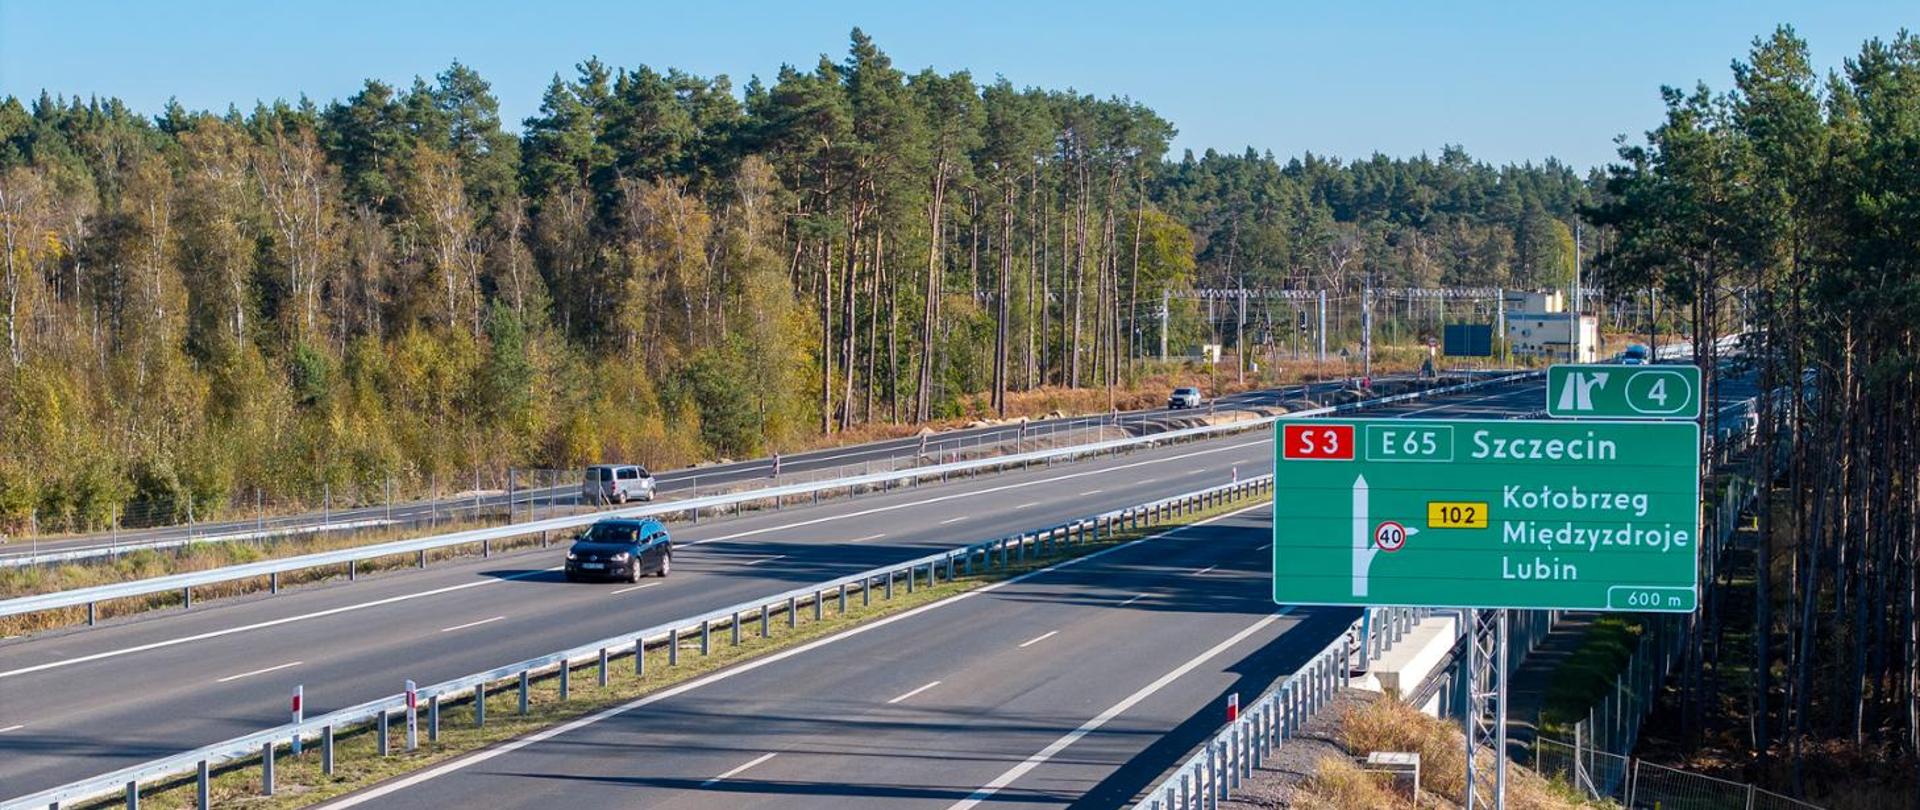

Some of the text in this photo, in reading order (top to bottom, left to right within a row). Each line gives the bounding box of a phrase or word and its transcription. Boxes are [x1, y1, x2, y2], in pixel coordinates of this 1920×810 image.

[1648, 378, 1667, 405] 4
[1472, 430, 1616, 459] Szczecin
[1503, 485, 1648, 517] Kołobrzeg
[1440, 506, 1476, 524] 102
[1379, 528, 1402, 544] 40
[1503, 521, 1689, 553] Międzyzdroje
[1503, 556, 1578, 580] Lubin
[1628, 592, 1681, 606] 600 m
